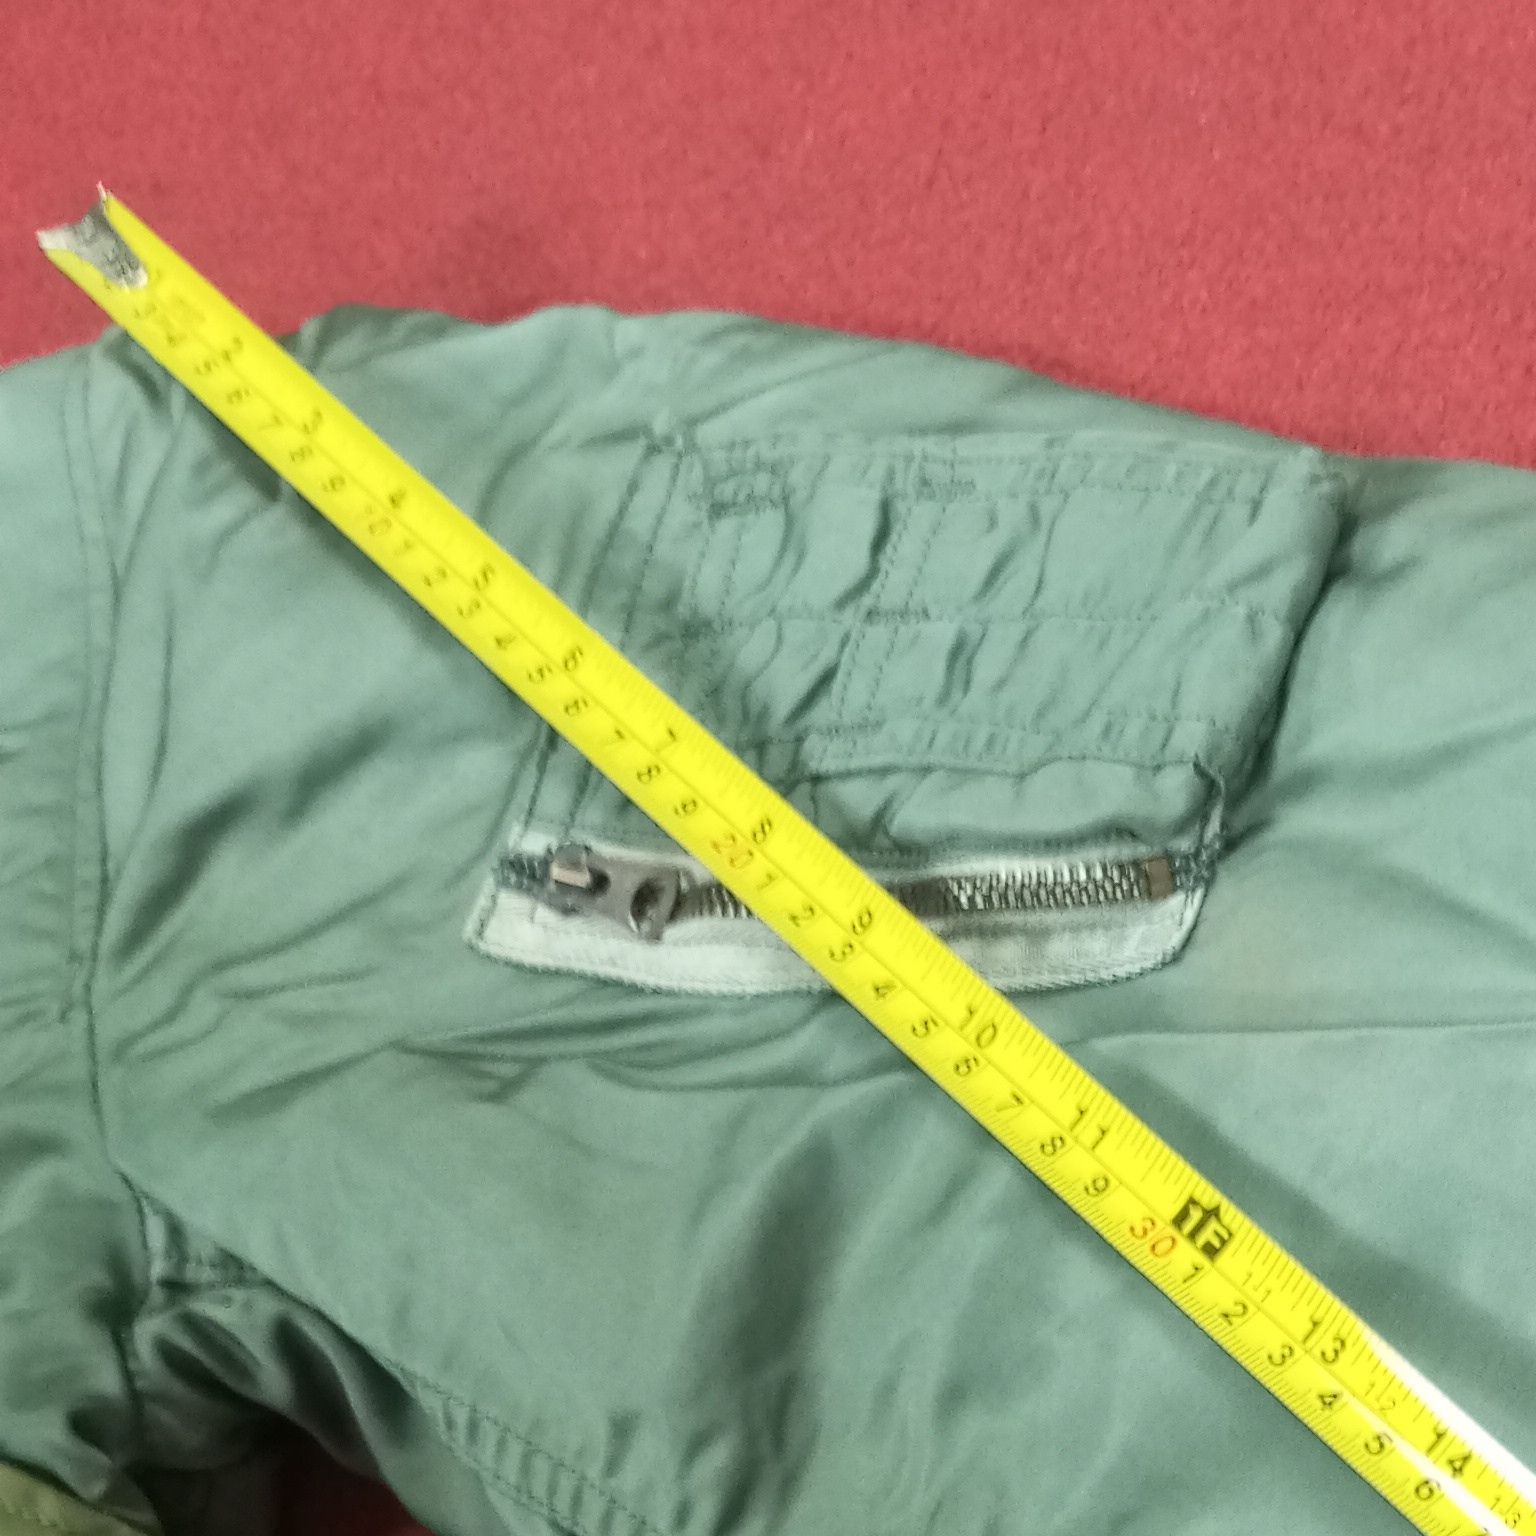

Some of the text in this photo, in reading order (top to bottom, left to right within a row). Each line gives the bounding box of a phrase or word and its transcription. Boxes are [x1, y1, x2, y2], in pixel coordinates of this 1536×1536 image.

[457, 598, 481, 619] 3
[495, 633, 518, 650] 4
[527, 664, 553, 684] 5
[564, 697, 589, 717] 6
[637, 764, 661, 784] 8
[673, 798, 697, 816] 9
[757, 872, 778, 890] 1
[789, 904, 815, 927] 2
[829, 942, 854, 962] 3
[874, 980, 897, 1001] 4
[911, 1017, 939, 1039] 5
[954, 1056, 980, 1077] 6
[996, 1092, 1024, 1113] 7
[1039, 1135, 1065, 1157] 8
[1084, 1176, 1110, 1198] 9
[1130, 1217, 1177, 1259] 30
[1183, 1264, 1203, 1284] 1
[1220, 1301, 1248, 1327] 2
[1267, 1344, 1295, 1367] 3
[1318, 1391, 1342, 1410] 4
[1364, 1432, 1394, 1456] 5
[1414, 1479, 1441, 1501] 6
[473, 564, 495, 590] 5
[564, 646, 584, 672] 6
[752, 816, 773, 844] 8
[852, 908, 873, 935] 9
[960, 1004, 997, 1050] 10
[1070, 1102, 1108, 1150] 11
[1303, 1313, 1346, 1364] 13
[1426, 1421, 1473, 1479] 14
